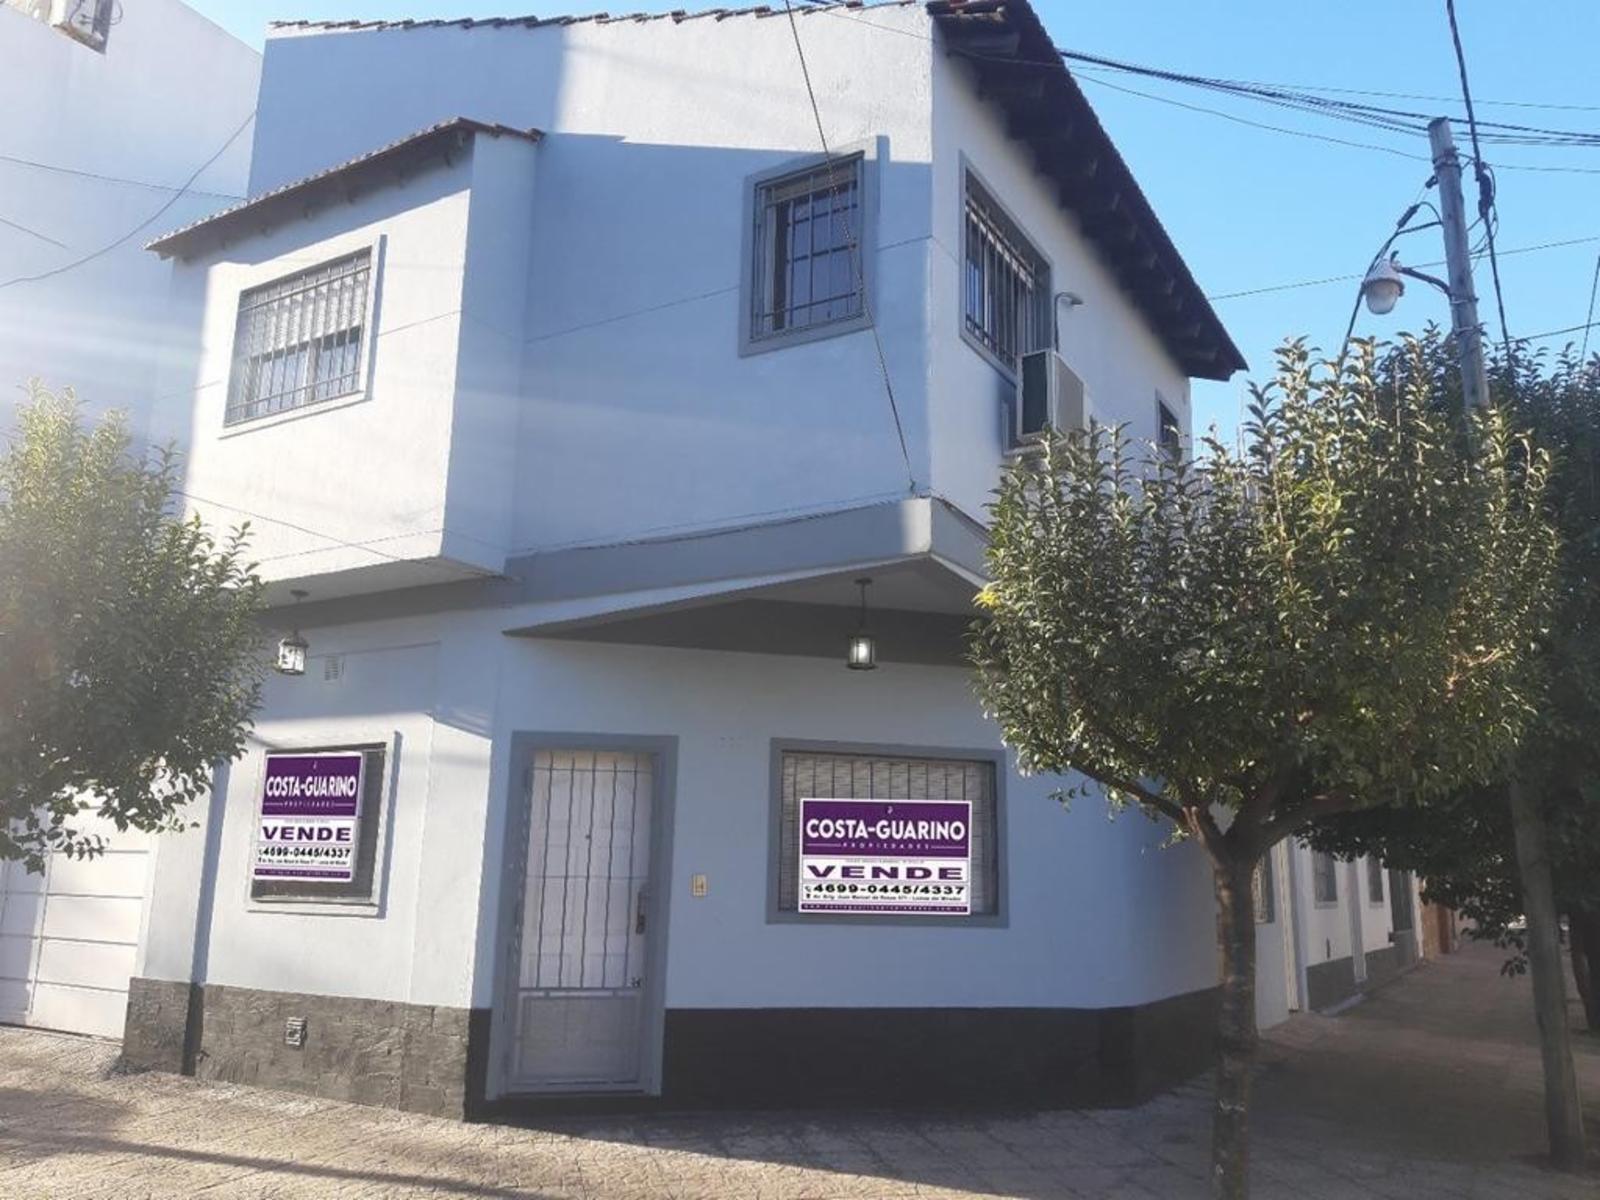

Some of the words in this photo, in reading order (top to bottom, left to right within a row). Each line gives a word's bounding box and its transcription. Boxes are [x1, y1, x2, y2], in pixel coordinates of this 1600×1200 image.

[266, 776, 356, 797] COSTA-GUARINO
[262, 826, 351, 841] VENDE
[806, 819, 965, 840] COSTA-GUARINO
[807, 865, 963, 880] VENDE
[813, 883, 965, 895] 4699-0445/4337
